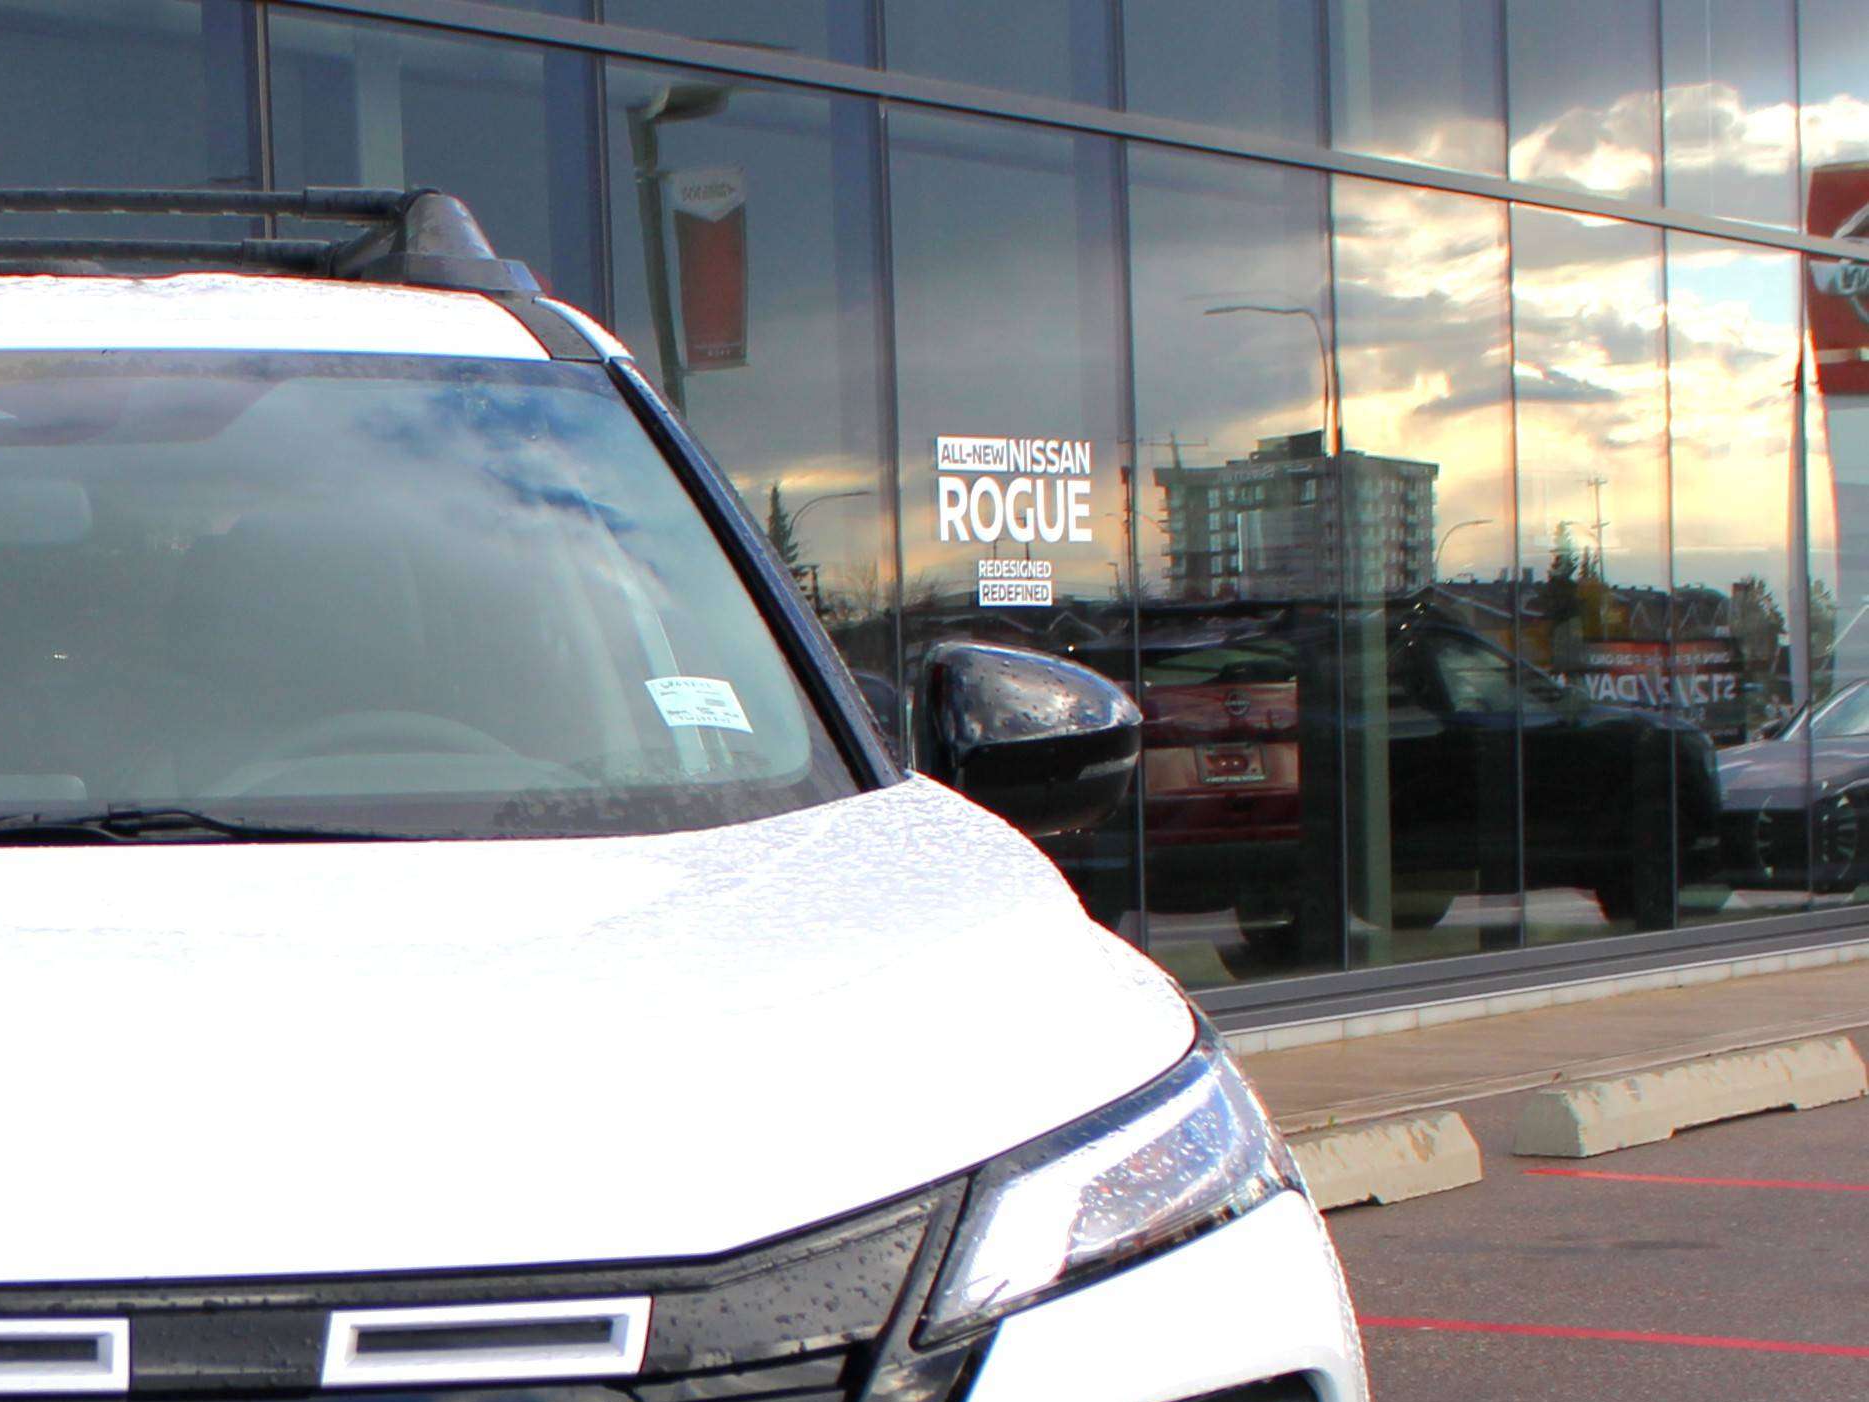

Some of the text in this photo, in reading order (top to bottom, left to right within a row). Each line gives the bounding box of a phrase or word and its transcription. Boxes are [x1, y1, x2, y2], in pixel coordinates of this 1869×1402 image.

[940, 438, 1090, 474] ALL-NEW NISSAN
[939, 476, 1092, 542] ROGUE
[979, 560, 1052, 578] REDESIGNED
[981, 584, 1050, 602] REDEFINED
